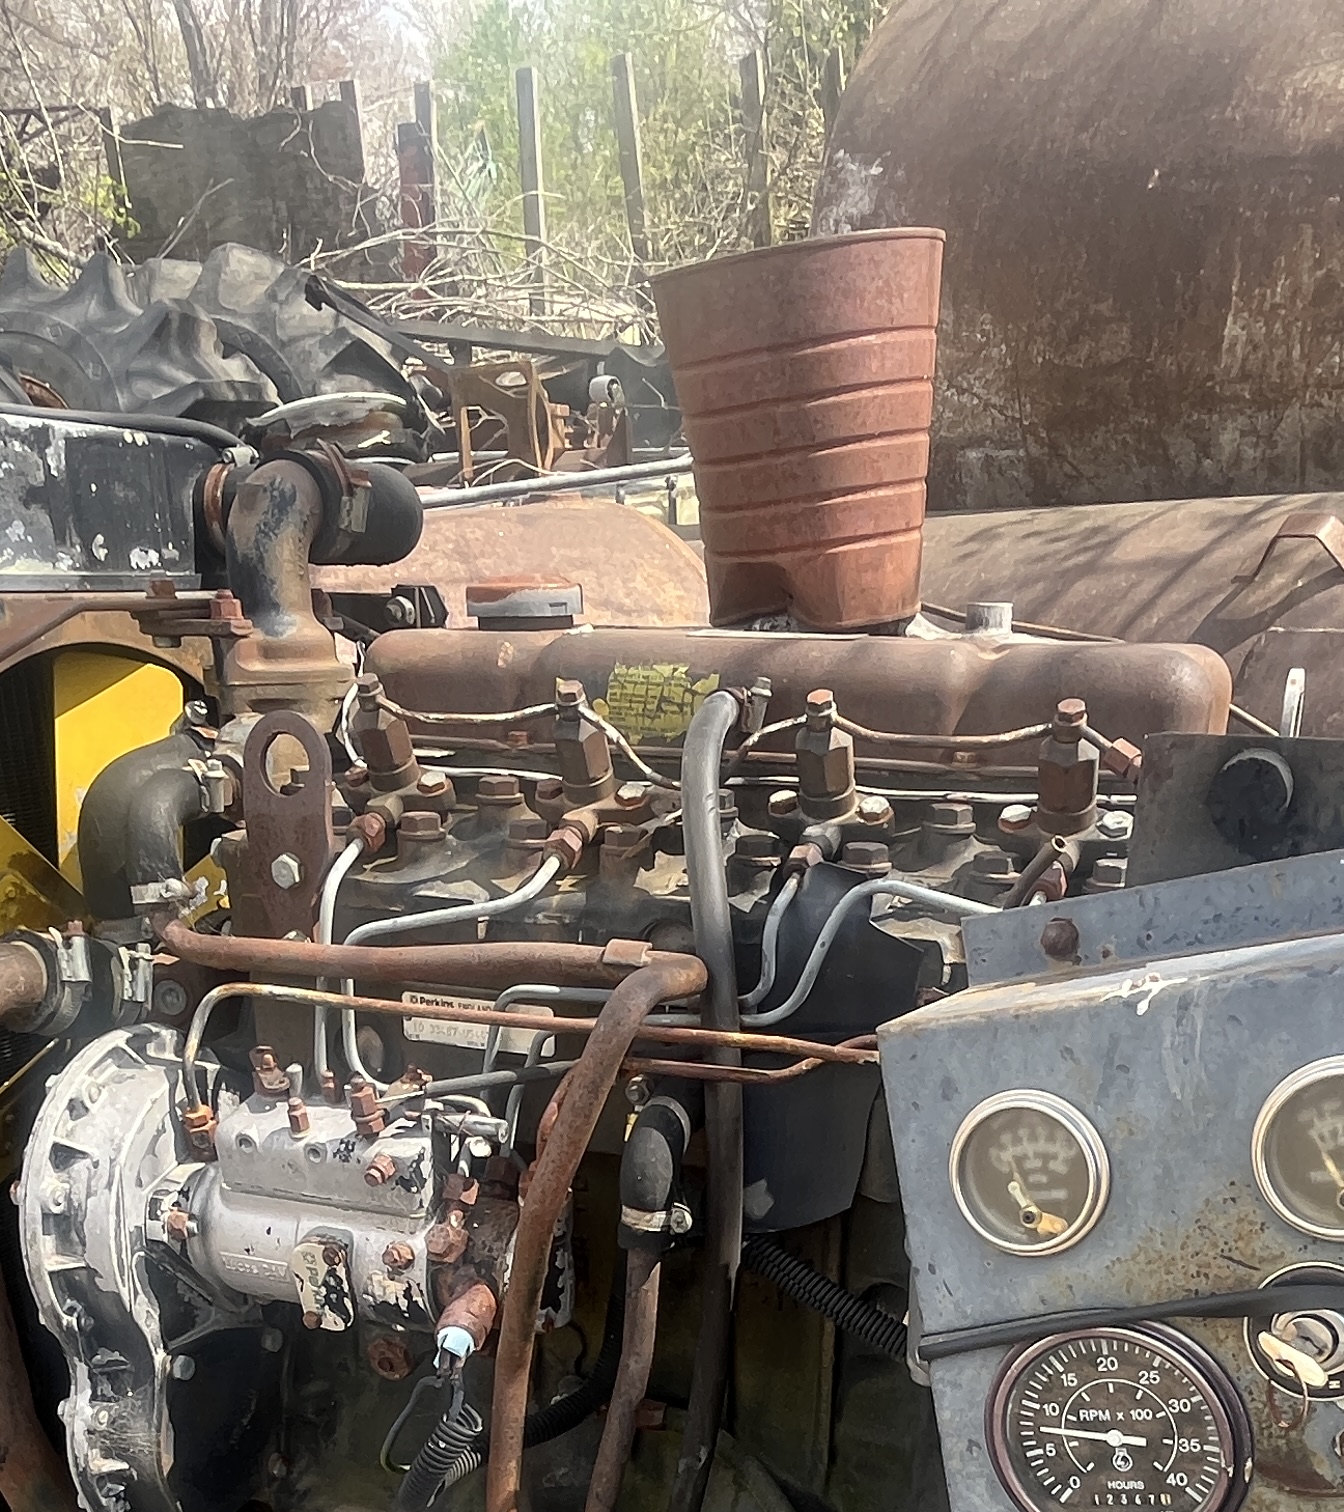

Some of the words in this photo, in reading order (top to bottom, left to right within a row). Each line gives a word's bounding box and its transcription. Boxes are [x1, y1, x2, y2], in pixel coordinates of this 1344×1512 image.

[419, 995, 454, 1009] Perkins
[1096, 1356, 1119, 1372] 20
[1060, 1373, 1078, 1387] 15
[1138, 1370, 1160, 1385] 25
[1042, 1402, 1060, 1417] 10
[1168, 1398, 1192, 1413] 30
[1079, 1408, 1112, 1422] RPM
[1130, 1409, 1153, 1421] 100
[1045, 1442, 1057, 1457] 5
[1178, 1438, 1202, 1453] 35
[1068, 1475, 1081, 1490] 0
[1106, 1480, 1146, 1490] HOURS
[1165, 1471, 1188, 1487] 40
